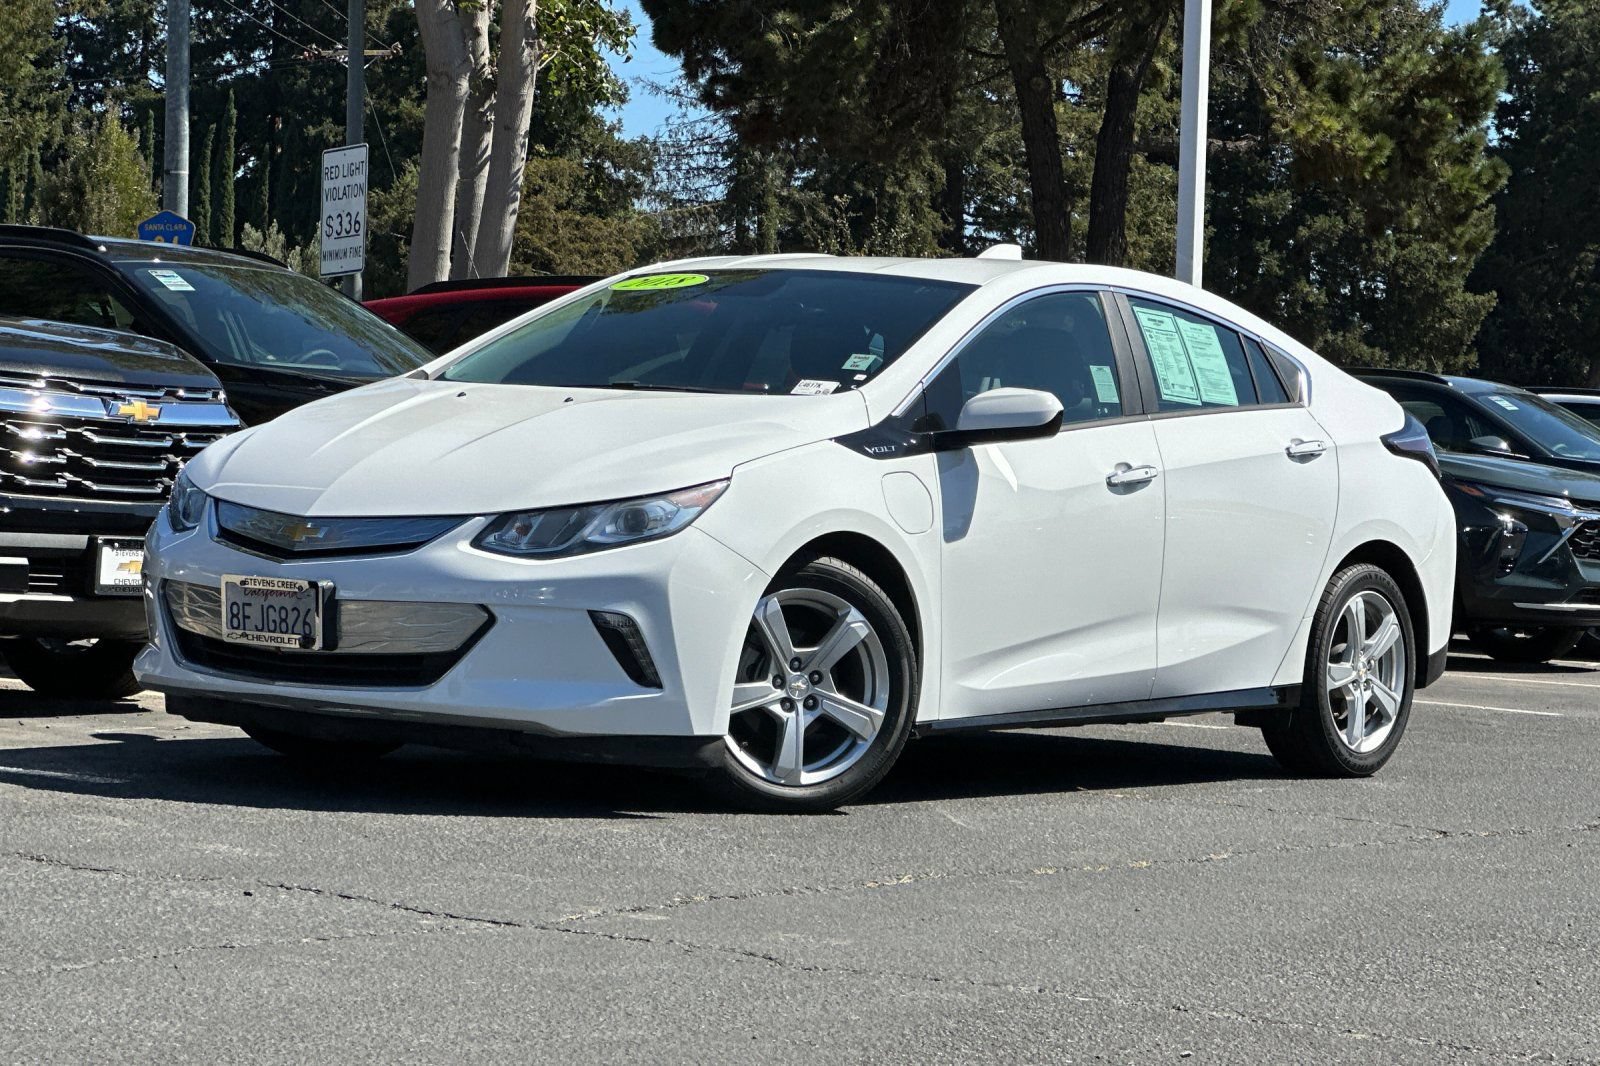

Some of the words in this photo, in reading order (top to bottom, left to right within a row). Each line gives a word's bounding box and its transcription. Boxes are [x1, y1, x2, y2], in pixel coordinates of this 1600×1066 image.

[325, 164, 339, 181] RED
[342, 160, 365, 178] LIGHT
[324, 182, 364, 202] VIOLATION
[144, 223, 164, 231] SANTA
[166, 223, 186, 231] CLARA
[325, 211, 361, 238] $336
[322, 247, 348, 262] MINIMUM
[349, 245, 362, 259] FINE
[863, 445, 897, 455] VOLT
[244, 578, 275, 588] STEVENS
[277, 580, 298, 589] CREEK
[229, 601, 312, 637] 8FJG826
[246, 634, 298, 645] CHEVROLET
